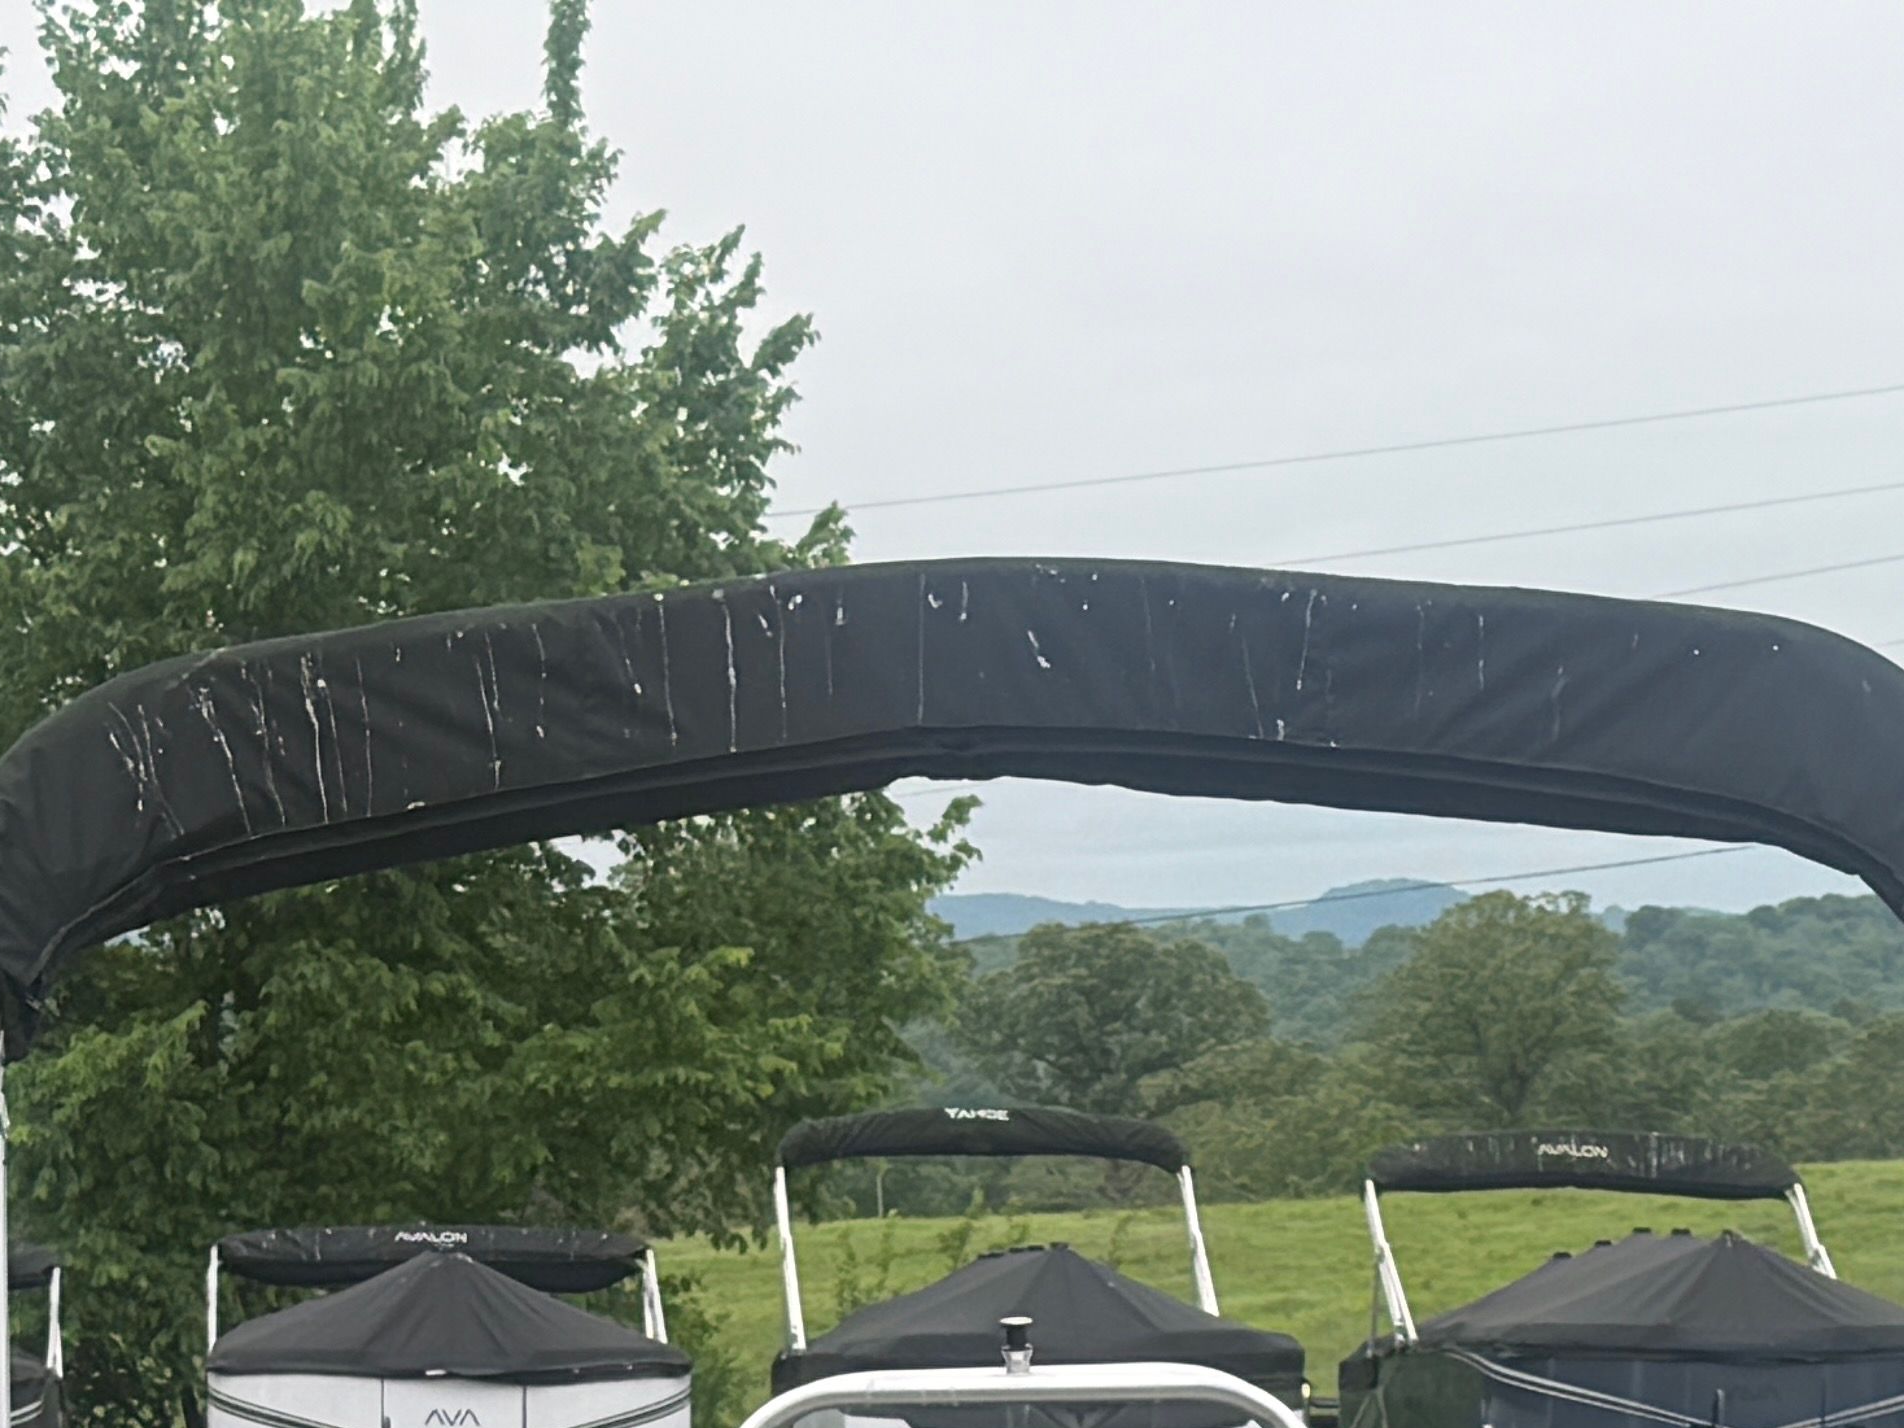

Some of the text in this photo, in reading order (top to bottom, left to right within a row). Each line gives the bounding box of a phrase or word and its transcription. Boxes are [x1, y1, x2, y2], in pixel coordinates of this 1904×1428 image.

[1537, 1144, 1609, 1158] AVALON
[394, 1231, 468, 1244] AVALON
[424, 1408, 480, 1426] AVA
